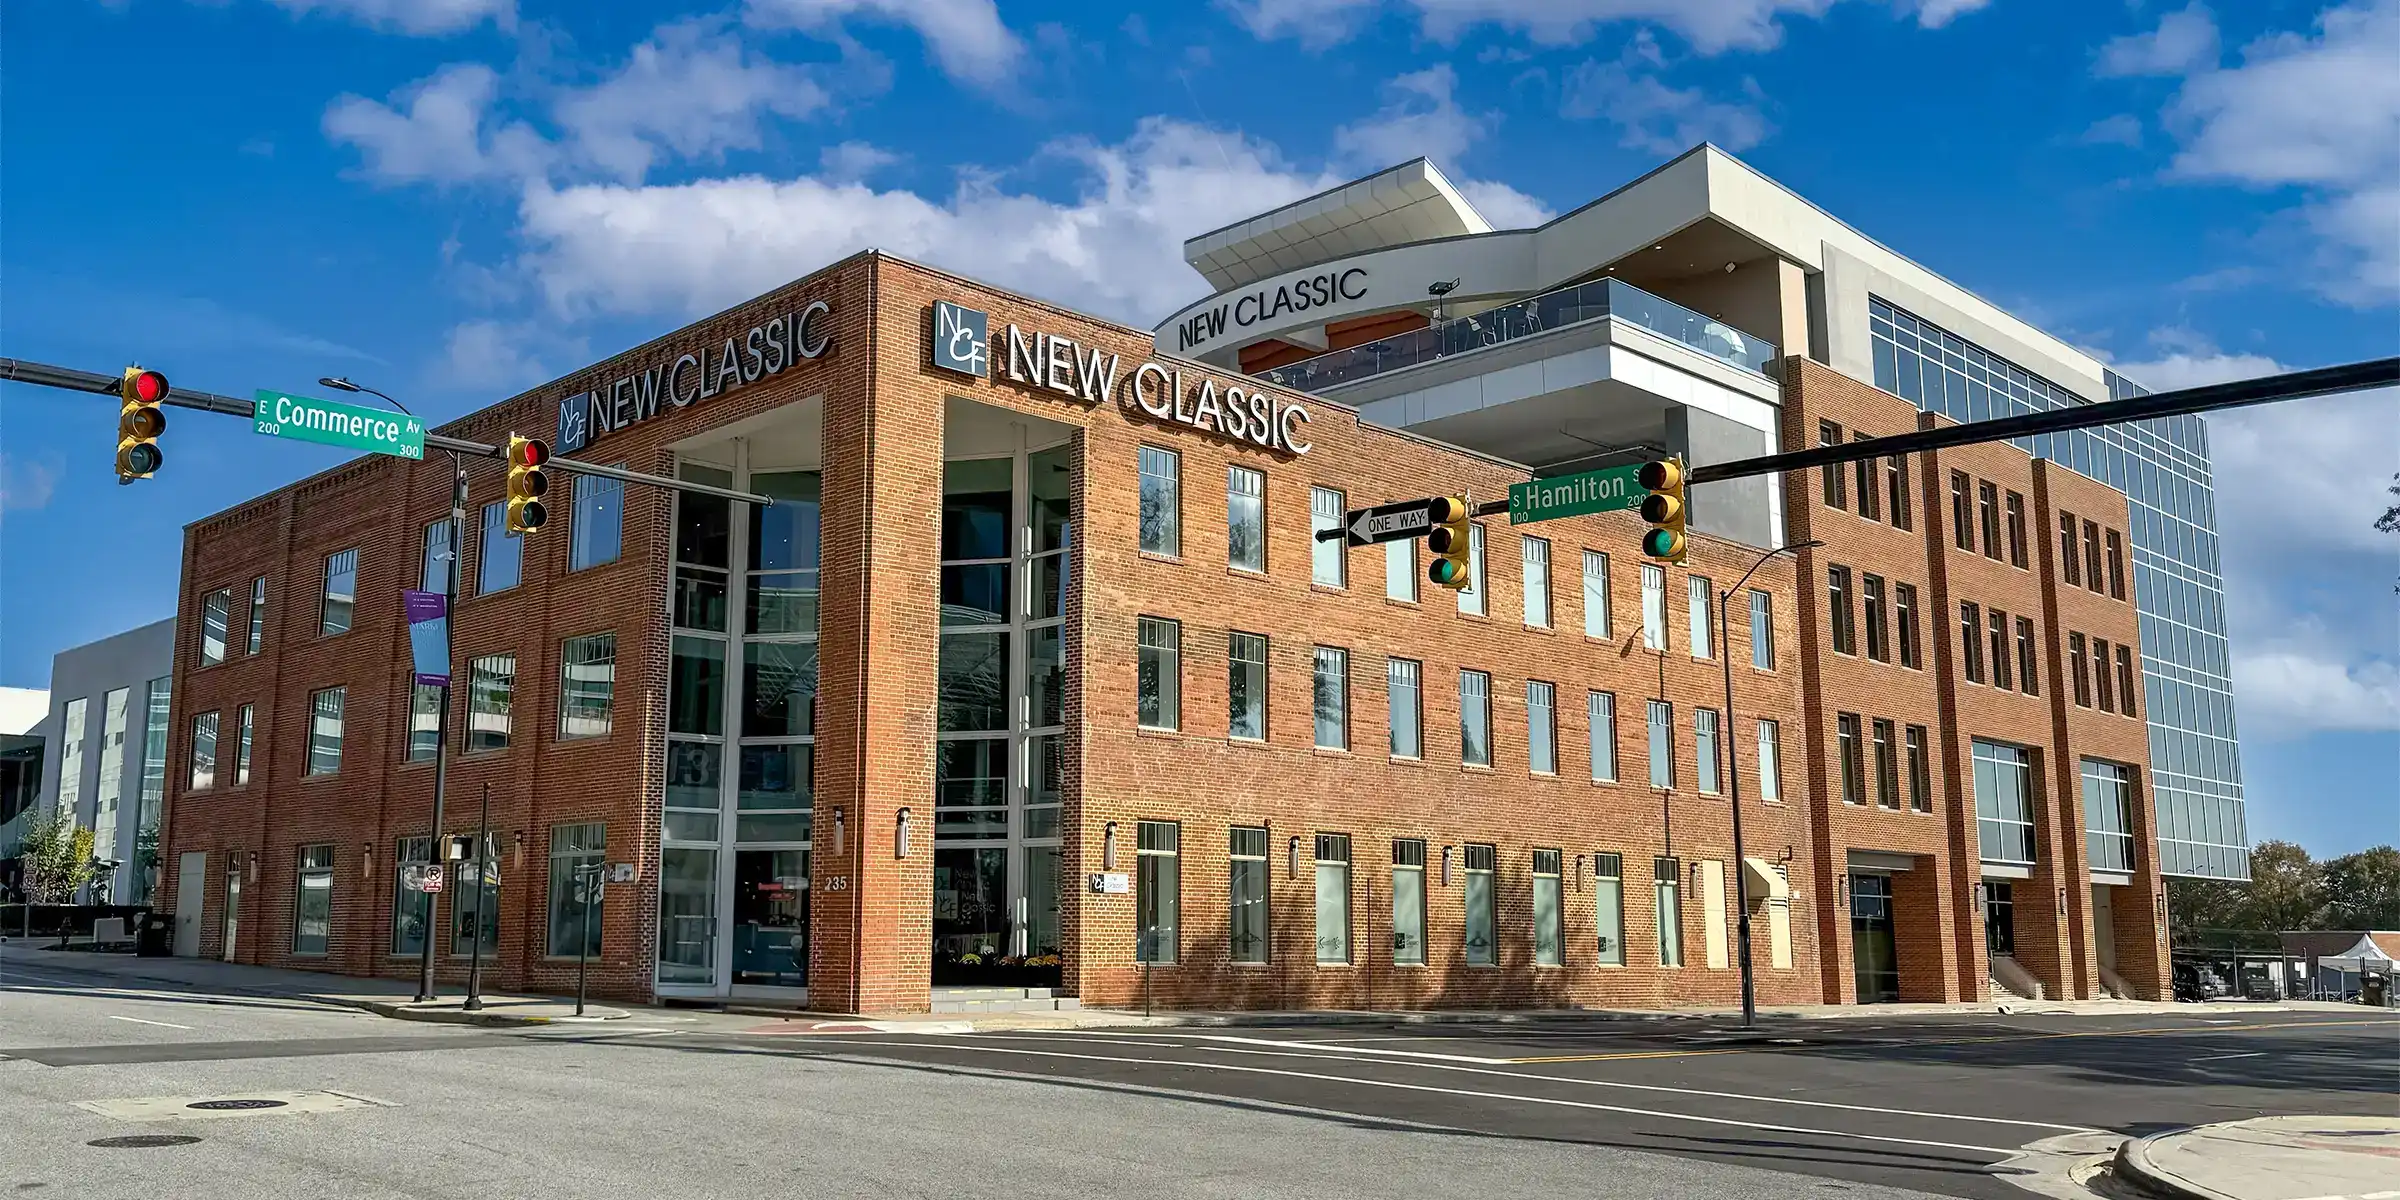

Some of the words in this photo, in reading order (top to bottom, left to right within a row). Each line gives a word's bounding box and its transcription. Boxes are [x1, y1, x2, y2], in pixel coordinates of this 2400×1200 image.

[1179, 304, 1229, 351] NEW
[1235, 268, 1368, 327] CLASSIC
[940, 303, 986, 373] NCF
[590, 363, 666, 438] NEW
[669, 301, 831, 407] CLASSIC
[1008, 324, 1119, 402] NEW
[1133, 363, 1312, 454] CLASSIC
[258, 422, 280, 435] 200
[259, 400, 268, 414] E
[276, 397, 399, 442] Commerce
[406, 420, 420, 433] Av
[560, 400, 586, 447] NCF
[400, 444, 419, 457] 300
[1513, 494, 1520, 507] S
[1526, 477, 1624, 509] Hamilton
[1368, 516, 1391, 533] ONE
[1400, 510, 1425, 528] WAY
[1513, 511, 1529, 523] 100
[824, 876, 847, 891] 235
